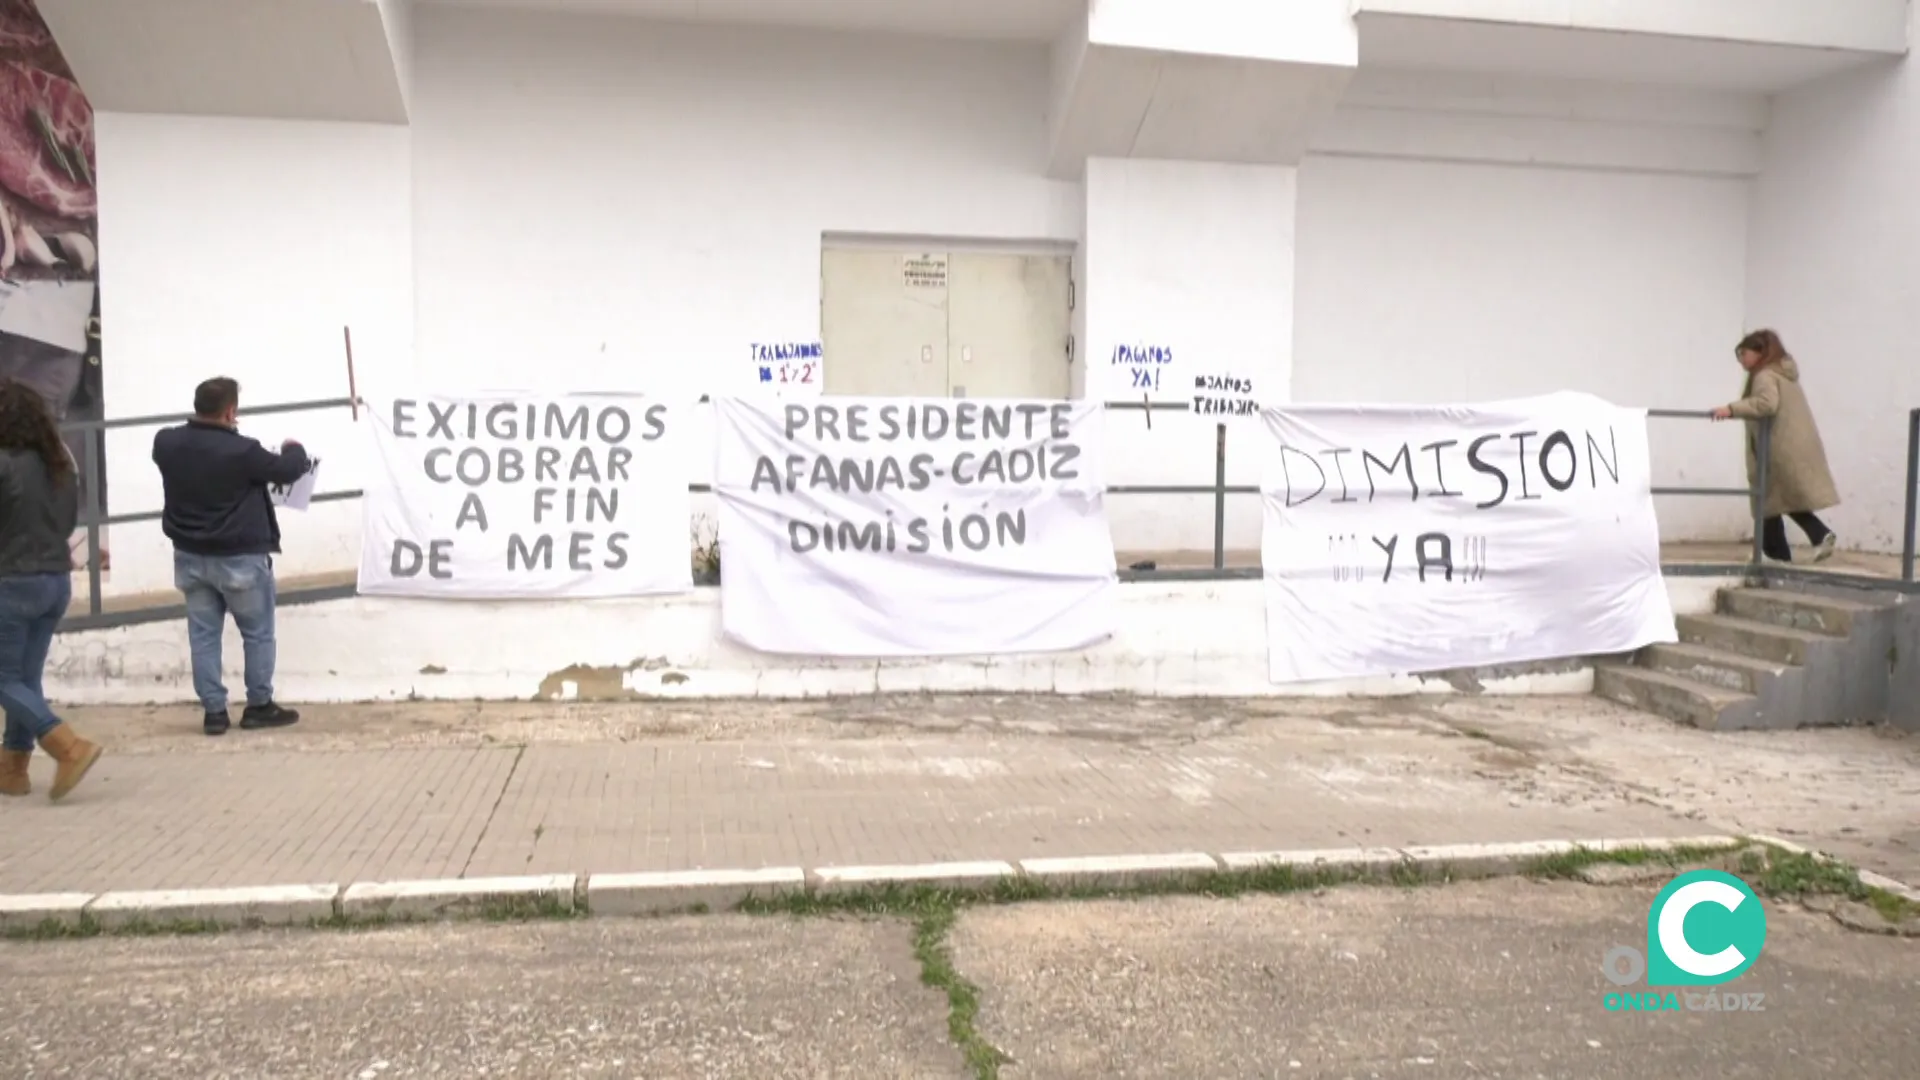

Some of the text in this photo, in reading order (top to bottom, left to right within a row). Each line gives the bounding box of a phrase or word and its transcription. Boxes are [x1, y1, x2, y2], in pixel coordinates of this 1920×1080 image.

[393, 399, 667, 443] EXIGIMOS
[784, 403, 1073, 442] PRESIDENTE
[423, 446, 633, 486] COBRAR
[1280, 425, 1620, 509] DIMISION
[455, 487, 619, 532] A FIN
[390, 532, 630, 579] DE MES
